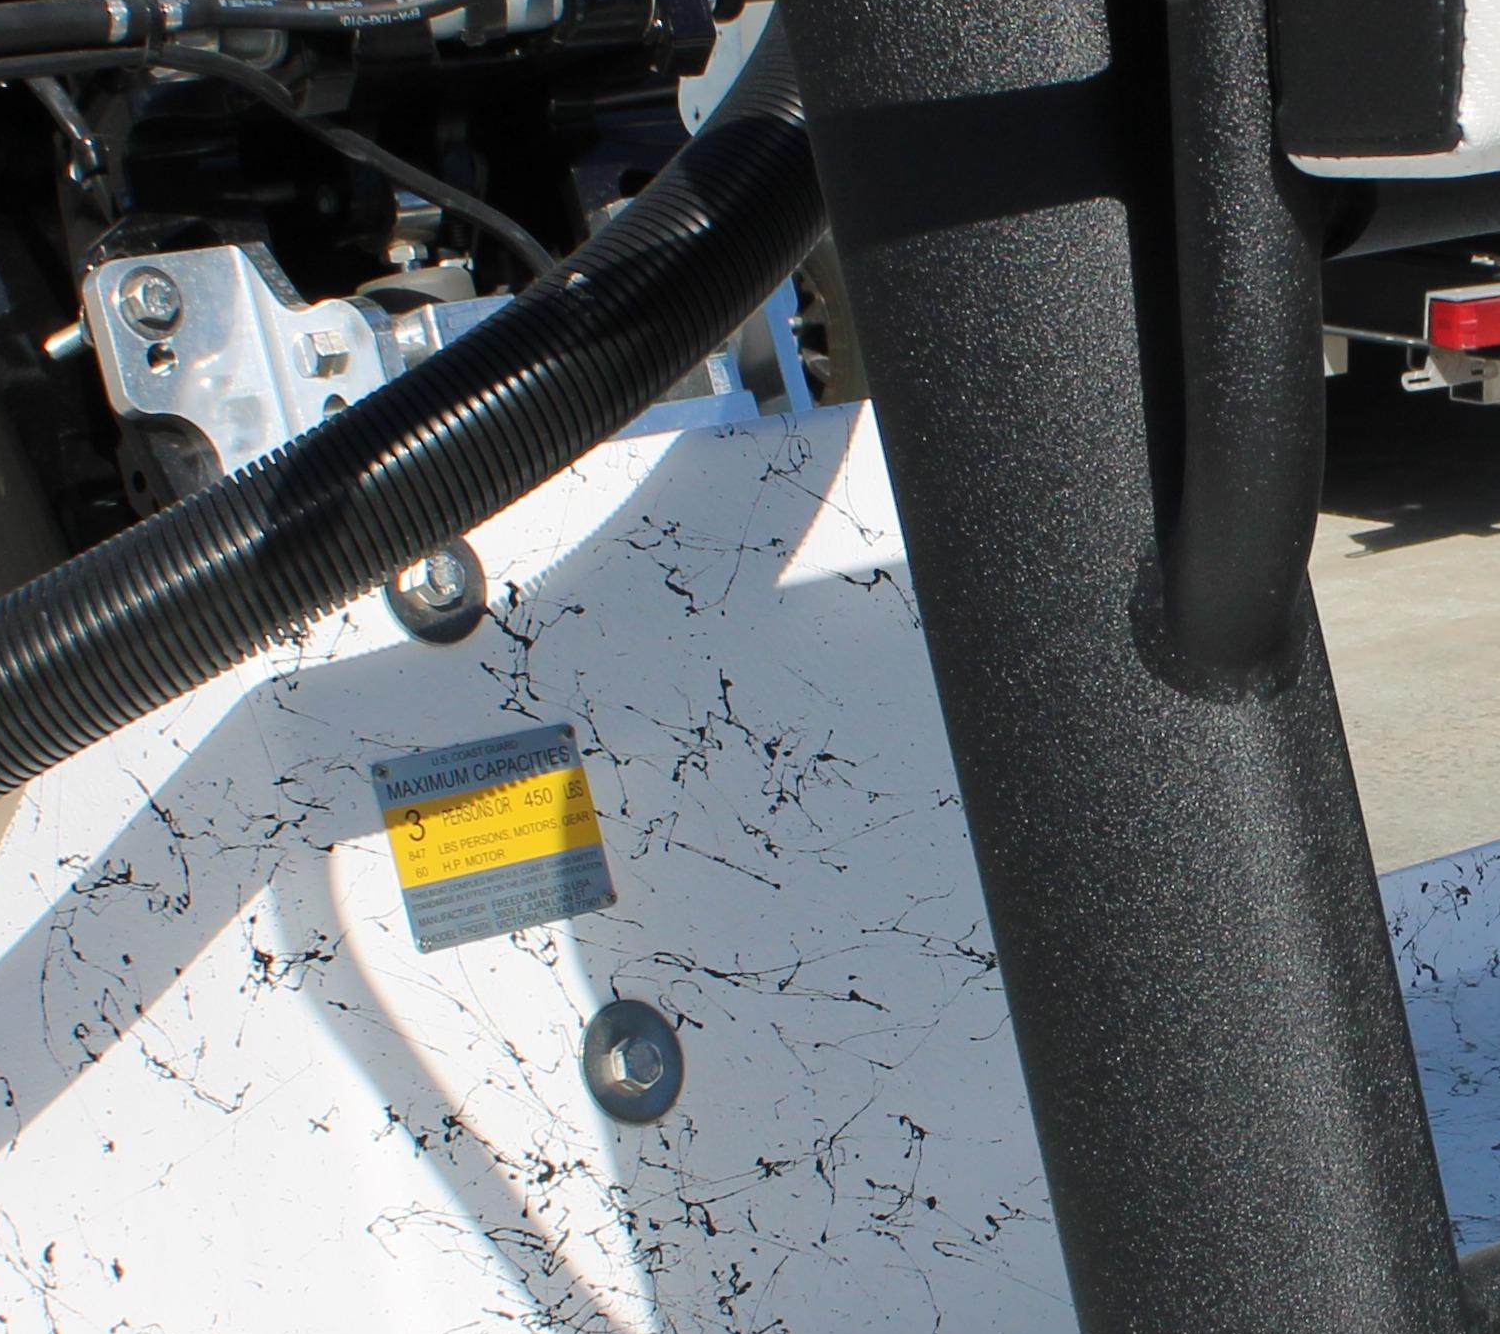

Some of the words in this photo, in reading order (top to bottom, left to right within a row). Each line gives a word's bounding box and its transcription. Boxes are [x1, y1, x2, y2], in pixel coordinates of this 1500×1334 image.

[431, 755, 449, 766] U.S.
[452, 748, 483, 762] COAST
[486, 740, 518, 754] GUARD
[387, 768, 469, 801] MAXIMUM
[473, 745, 570, 782] CAPACITIES
[405, 810, 425, 841] 3
[442, 801, 493, 827] PERSONS
[495, 797, 512, 815] OR
[523, 788, 553, 808] 450
[564, 781, 583, 799] LBS
[409, 849, 427, 862] 847
[438, 842, 458, 855] LBS
[563, 811, 589, 826] GEAR
[416, 867, 428, 878] 60
[443, 859, 464, 872] H.P.
[466, 849, 505, 867] MOTOR
[492, 891, 537, 909] FREEDOM
[540, 883, 570, 897] BOATS
[572, 878, 590, 889] USA
[527, 899, 550, 911] JUAN
[546, 903, 575, 918] TEXAS
